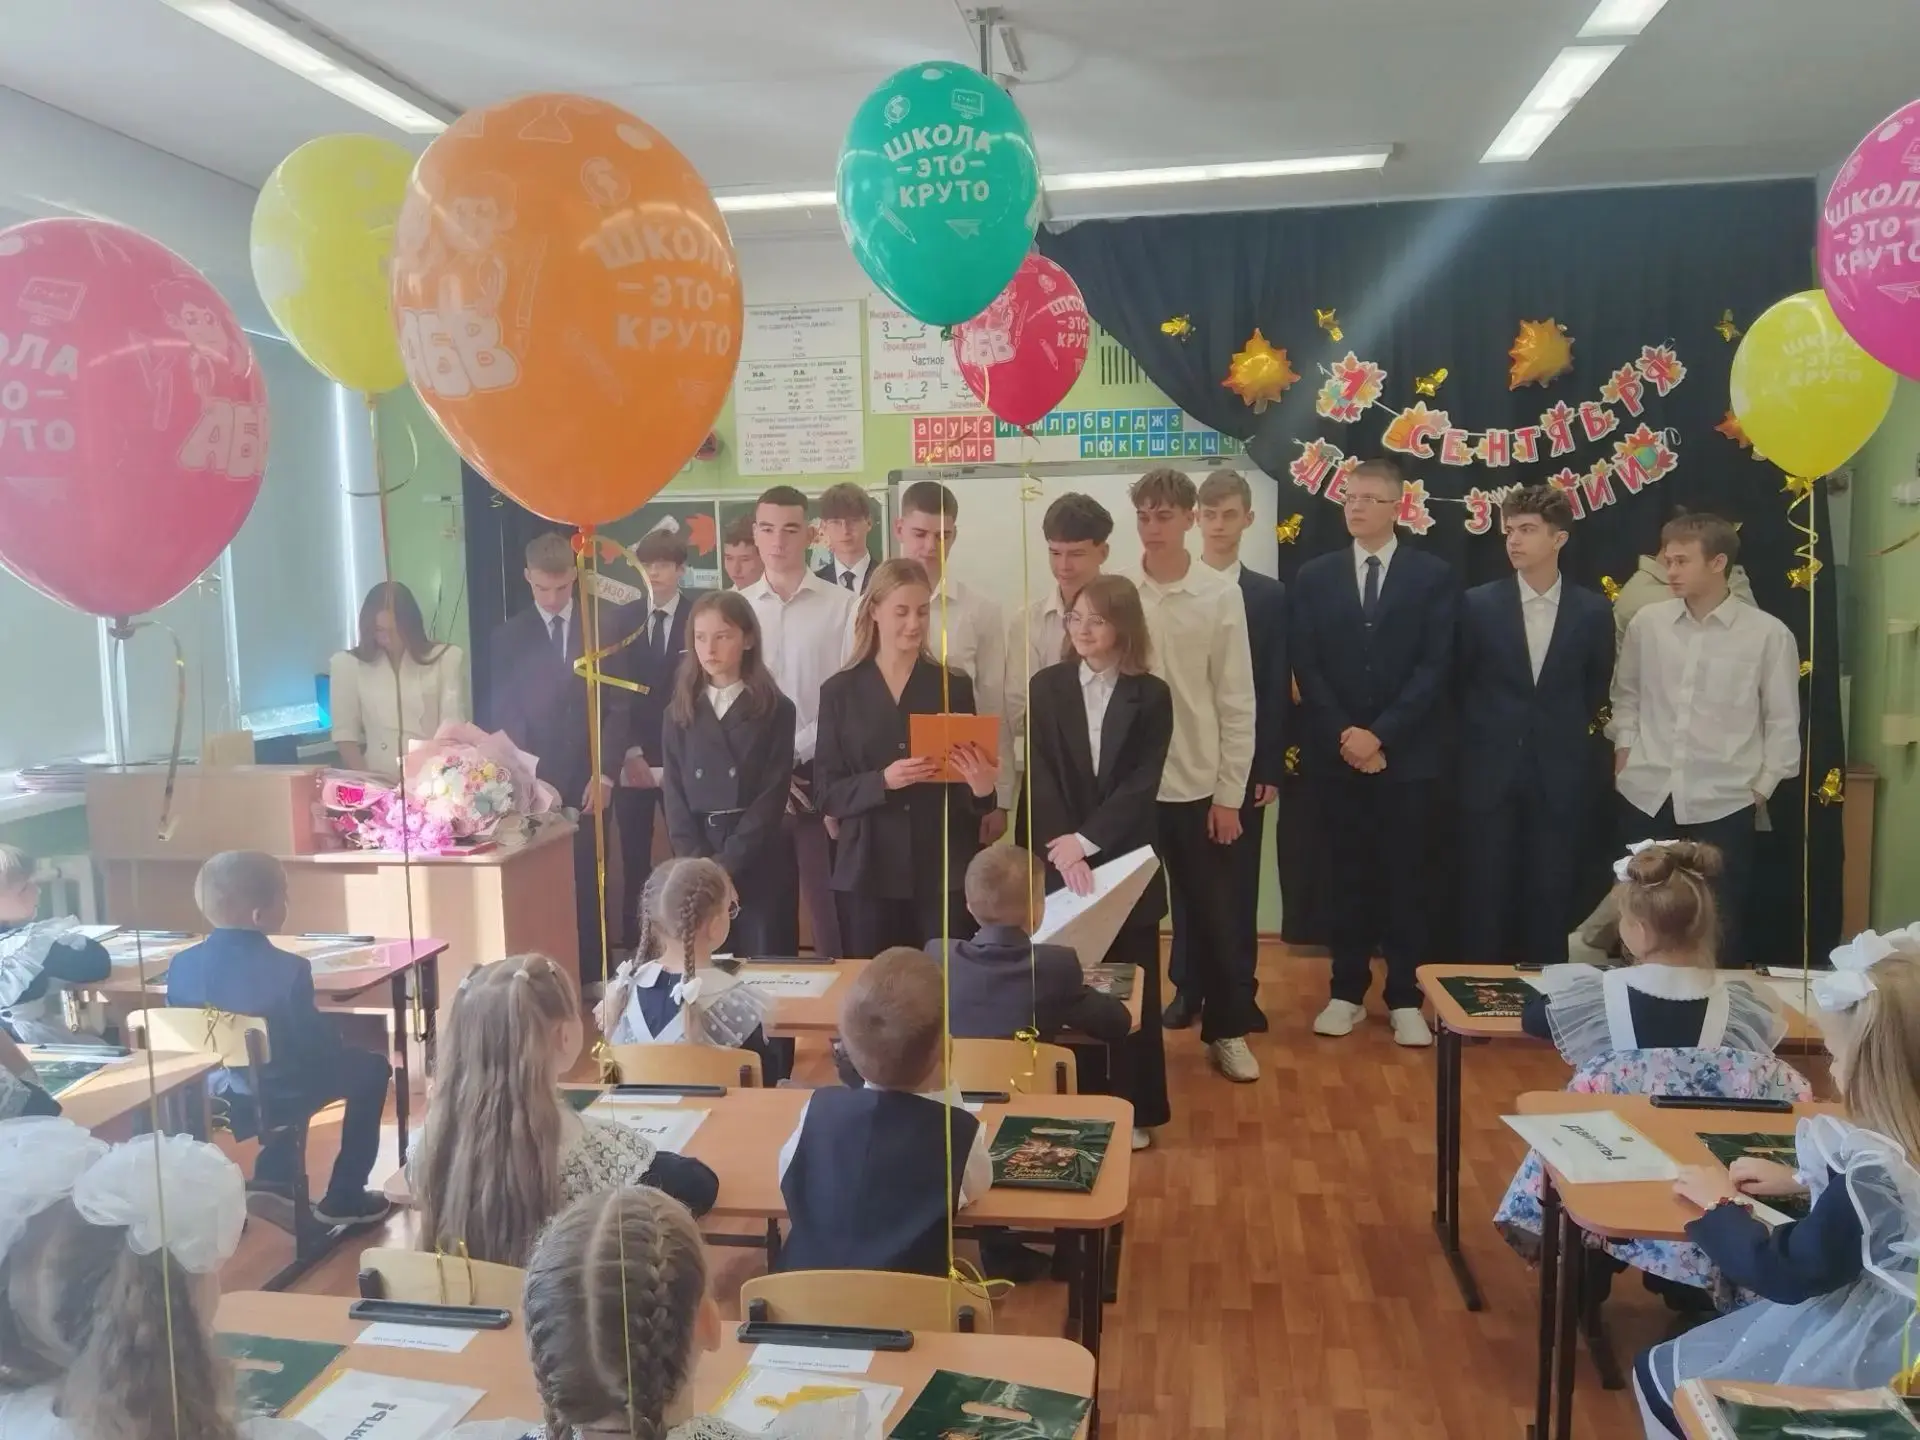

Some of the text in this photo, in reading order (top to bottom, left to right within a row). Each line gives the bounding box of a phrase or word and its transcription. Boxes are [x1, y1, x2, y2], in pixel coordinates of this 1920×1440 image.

[883, 124, 991, 161] ШКОЛА
[916, 155, 967, 178] ЭТО
[899, 180, 990, 208] КРУТО
[1827, 181, 1920, 230] ШКОЛ
[1848, 216, 1901, 246] ЭТО
[650, 274, 713, 311] ЭТО
[616, 314, 731, 356] КРУТО
[1057, 332, 1088, 349] КРУТ
[1782, 331, 1860, 356] ШКО
[912, 354, 945, 366] Частное
[920, 381, 928, 393] 2
[1409, 358, 1669, 467] СЕНТЯБРЯ
[178, 398, 269, 480] АБ
[1294, 456, 1422, 523] ДЕЬ
